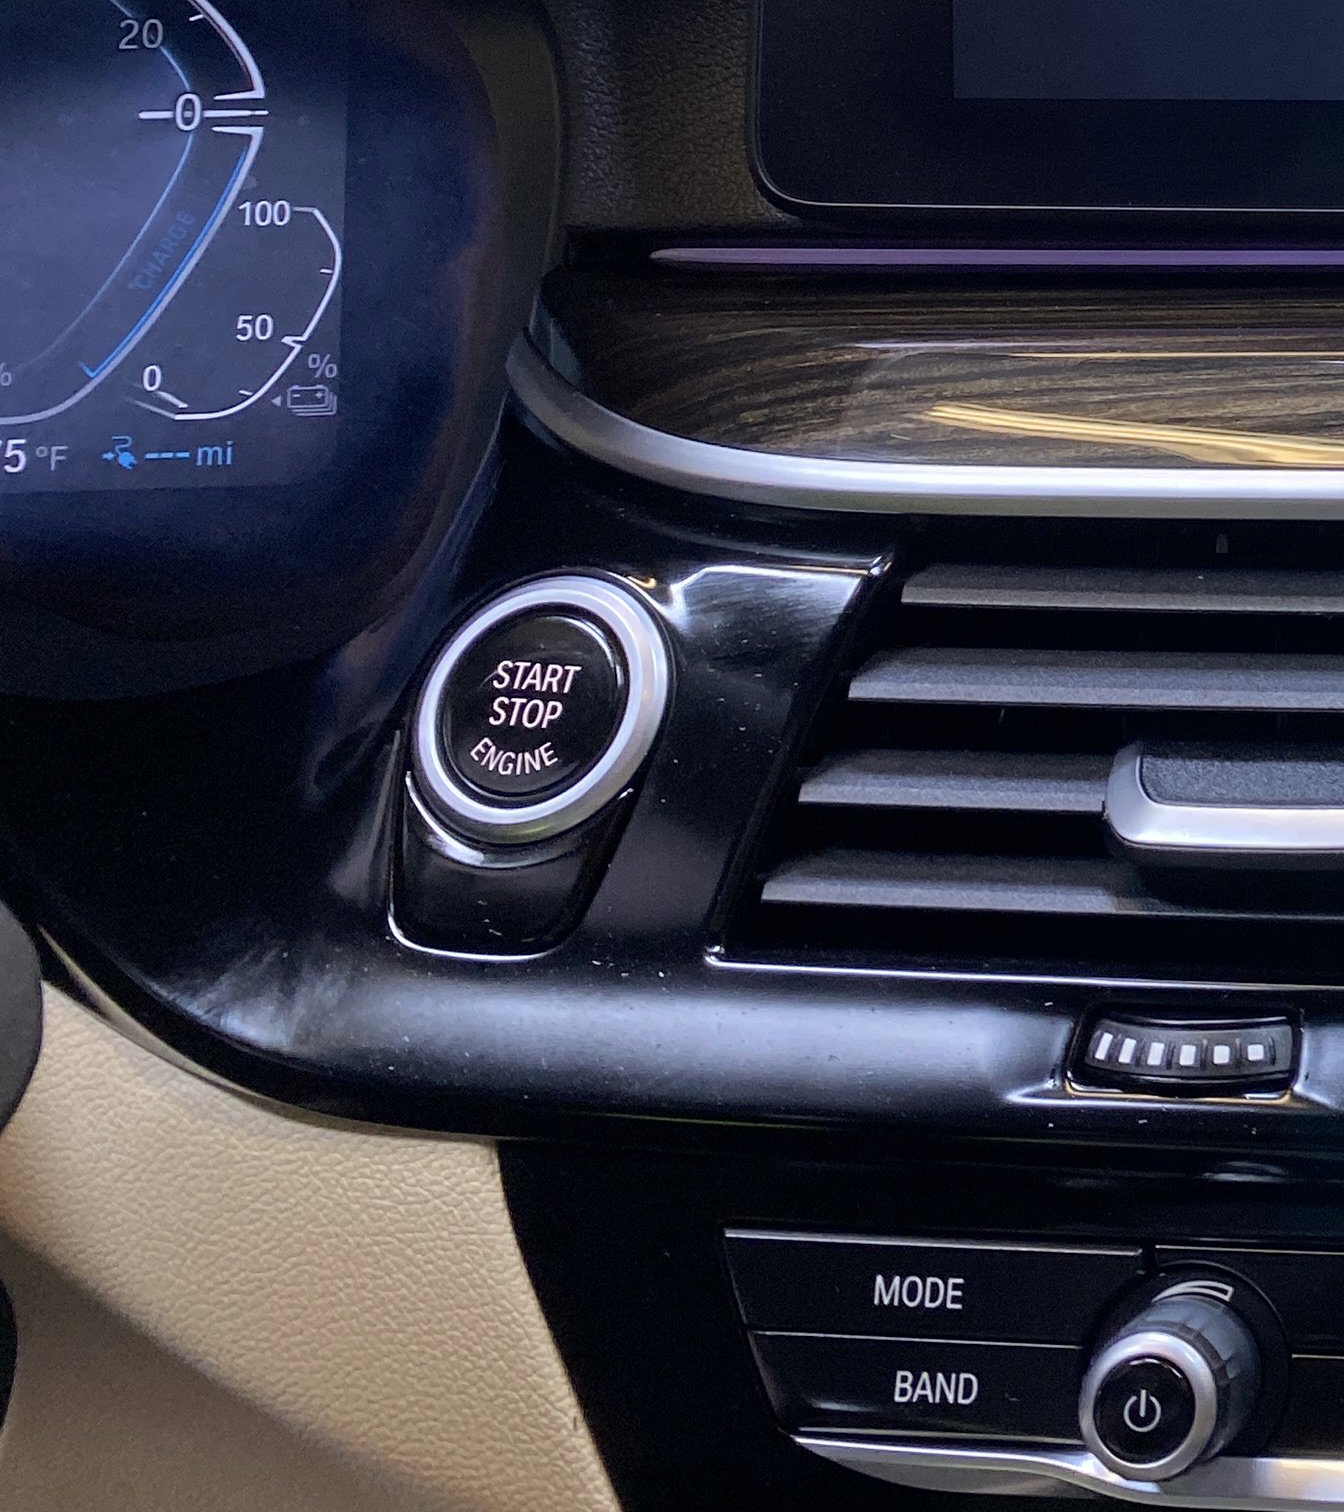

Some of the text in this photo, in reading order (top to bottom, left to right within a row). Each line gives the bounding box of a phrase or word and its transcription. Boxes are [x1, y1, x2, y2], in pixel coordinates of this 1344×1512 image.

[117, 16, 164, 53] 20
[174, 91, 201, 133] 0
[238, 200, 291, 227] 100
[235, 314, 274, 341] 50
[142, 364, 163, 392] 0
[196, 440, 234, 466] mi
[491, 660, 582, 694] START
[488, 696, 563, 729] STOP
[469, 737, 559, 776] ENGINE
[873, 1274, 965, 1310] MODE
[893, 1370, 979, 1405] BAND
